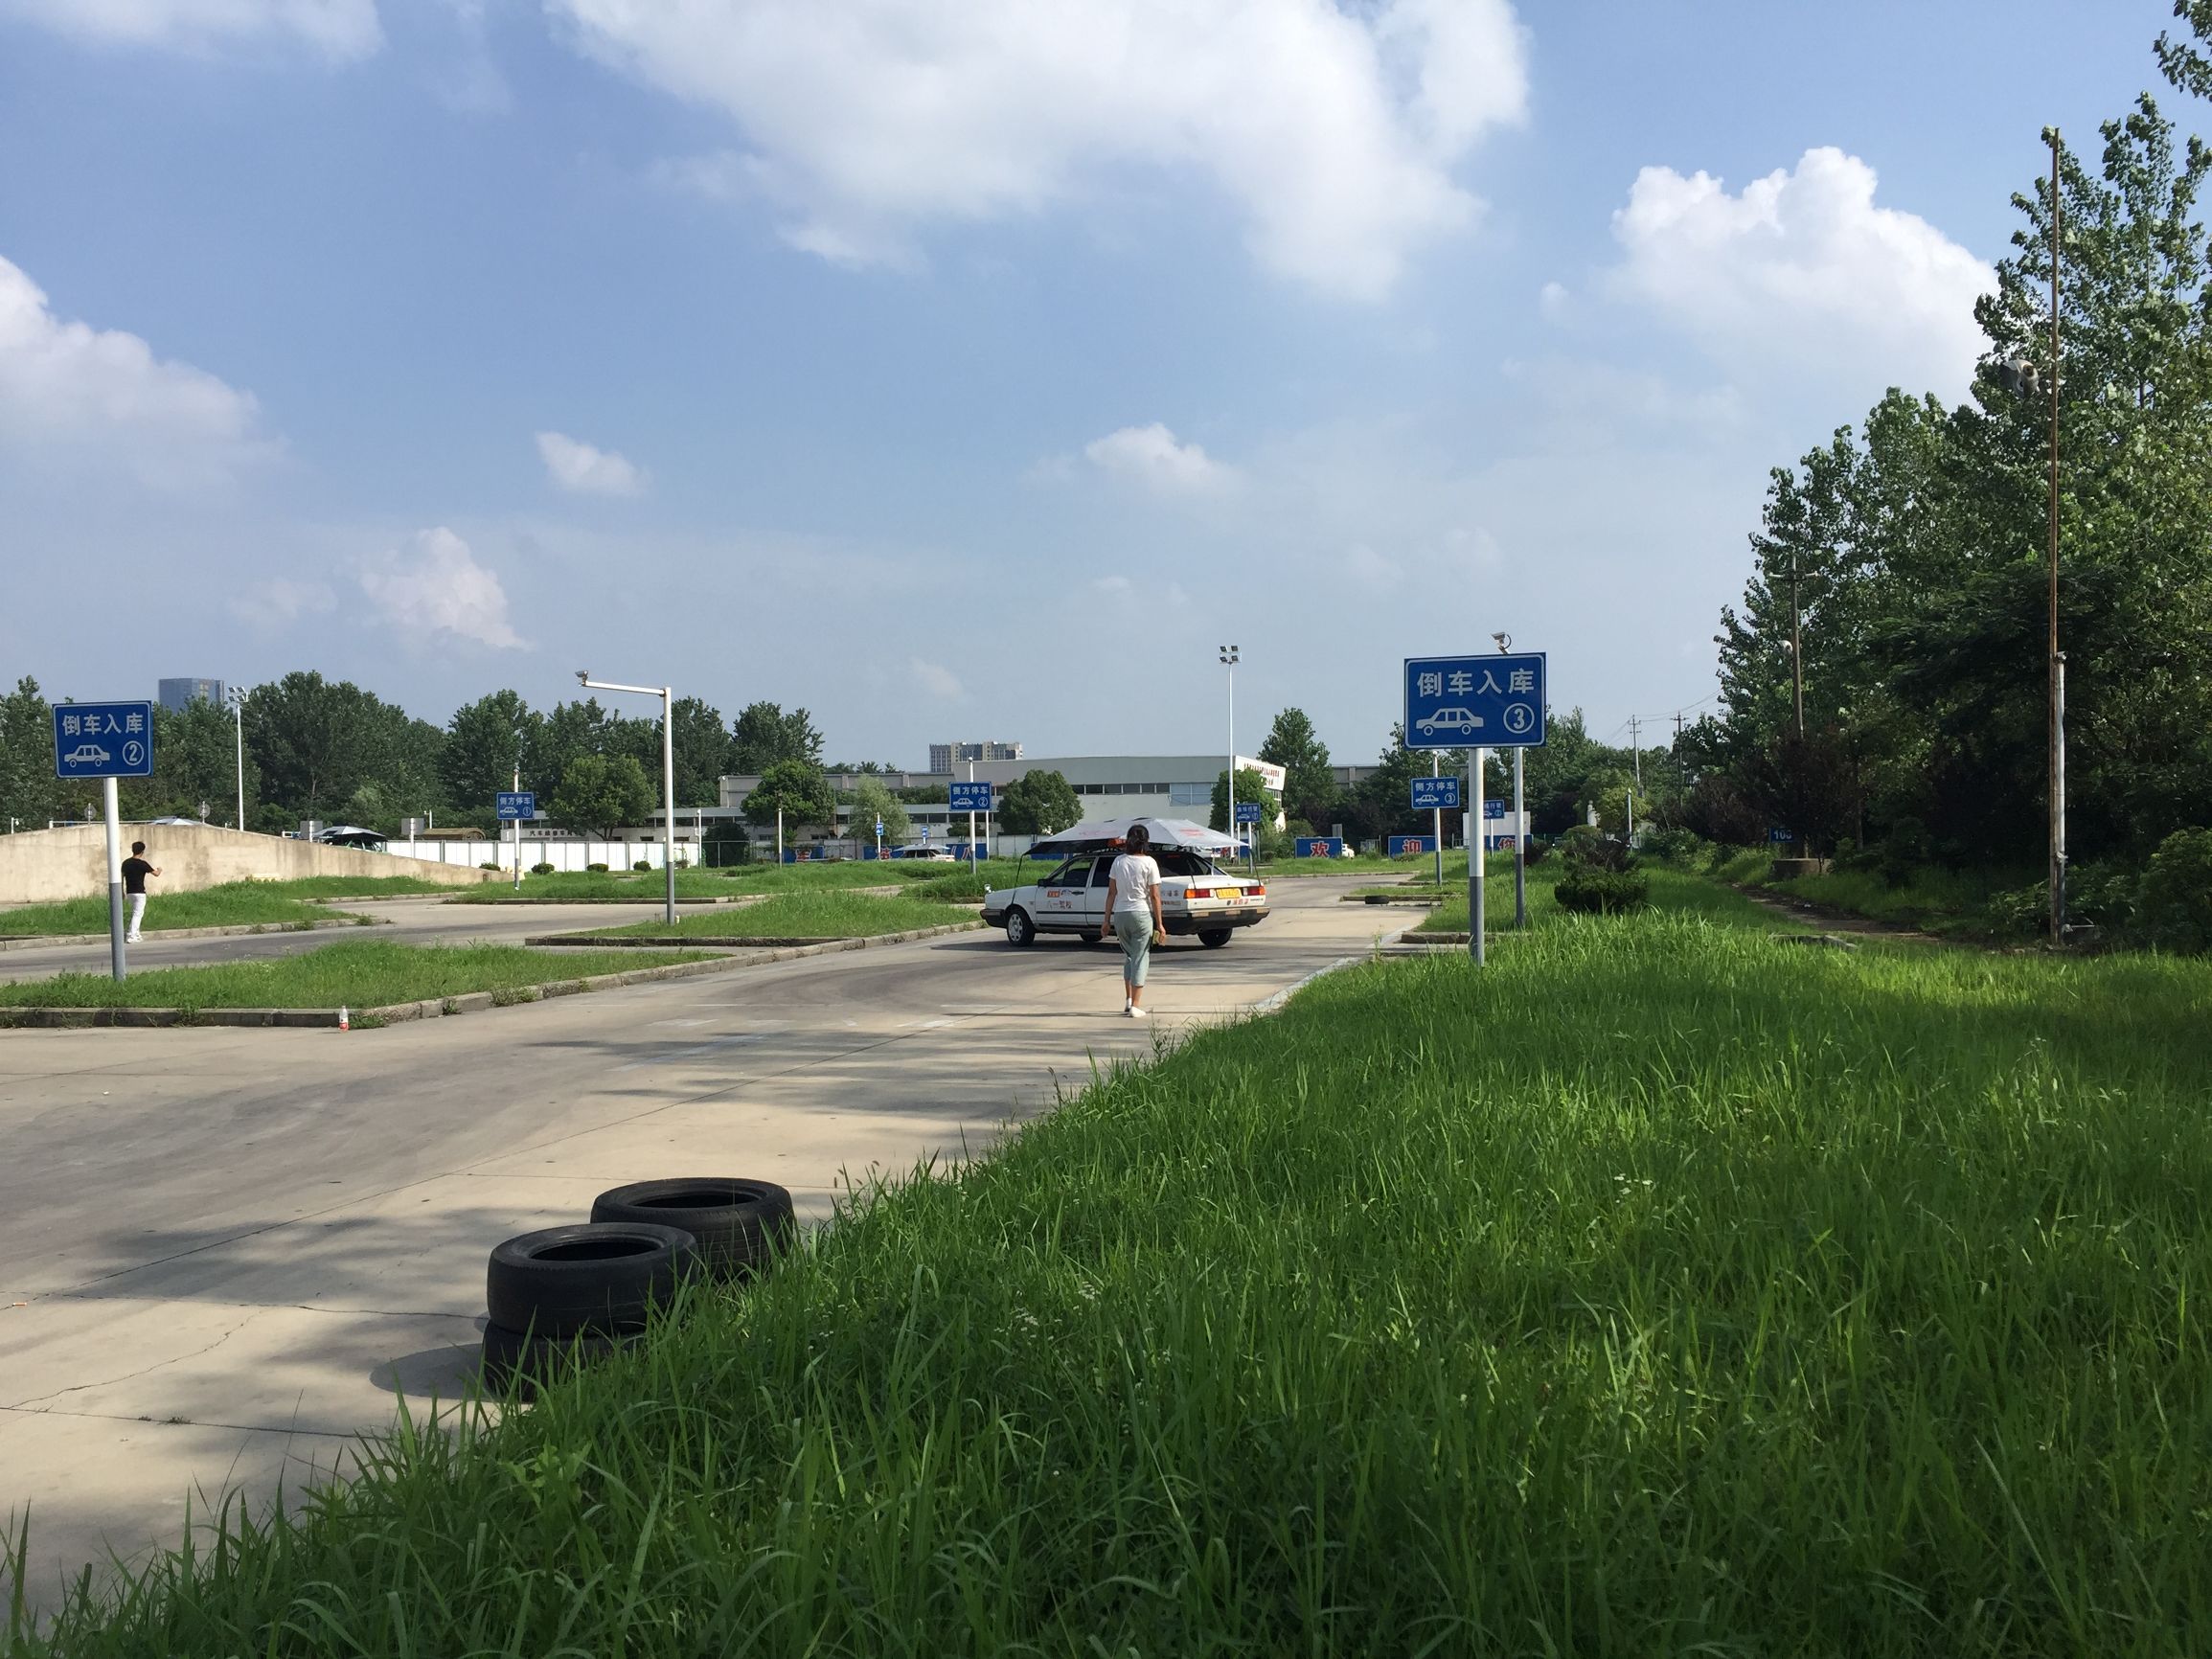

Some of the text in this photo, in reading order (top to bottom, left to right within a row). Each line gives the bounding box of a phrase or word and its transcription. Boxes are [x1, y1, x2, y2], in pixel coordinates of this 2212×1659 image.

[1417, 668, 1535, 697] 倒车入库
[62, 712, 144, 736] 倒车入库
[953, 785, 989, 795] 侧方停车
[1415, 782, 1456, 791] 侧方停车
[1310, 841, 1330, 859] 欢
[1402, 838, 1423, 854] 迎
